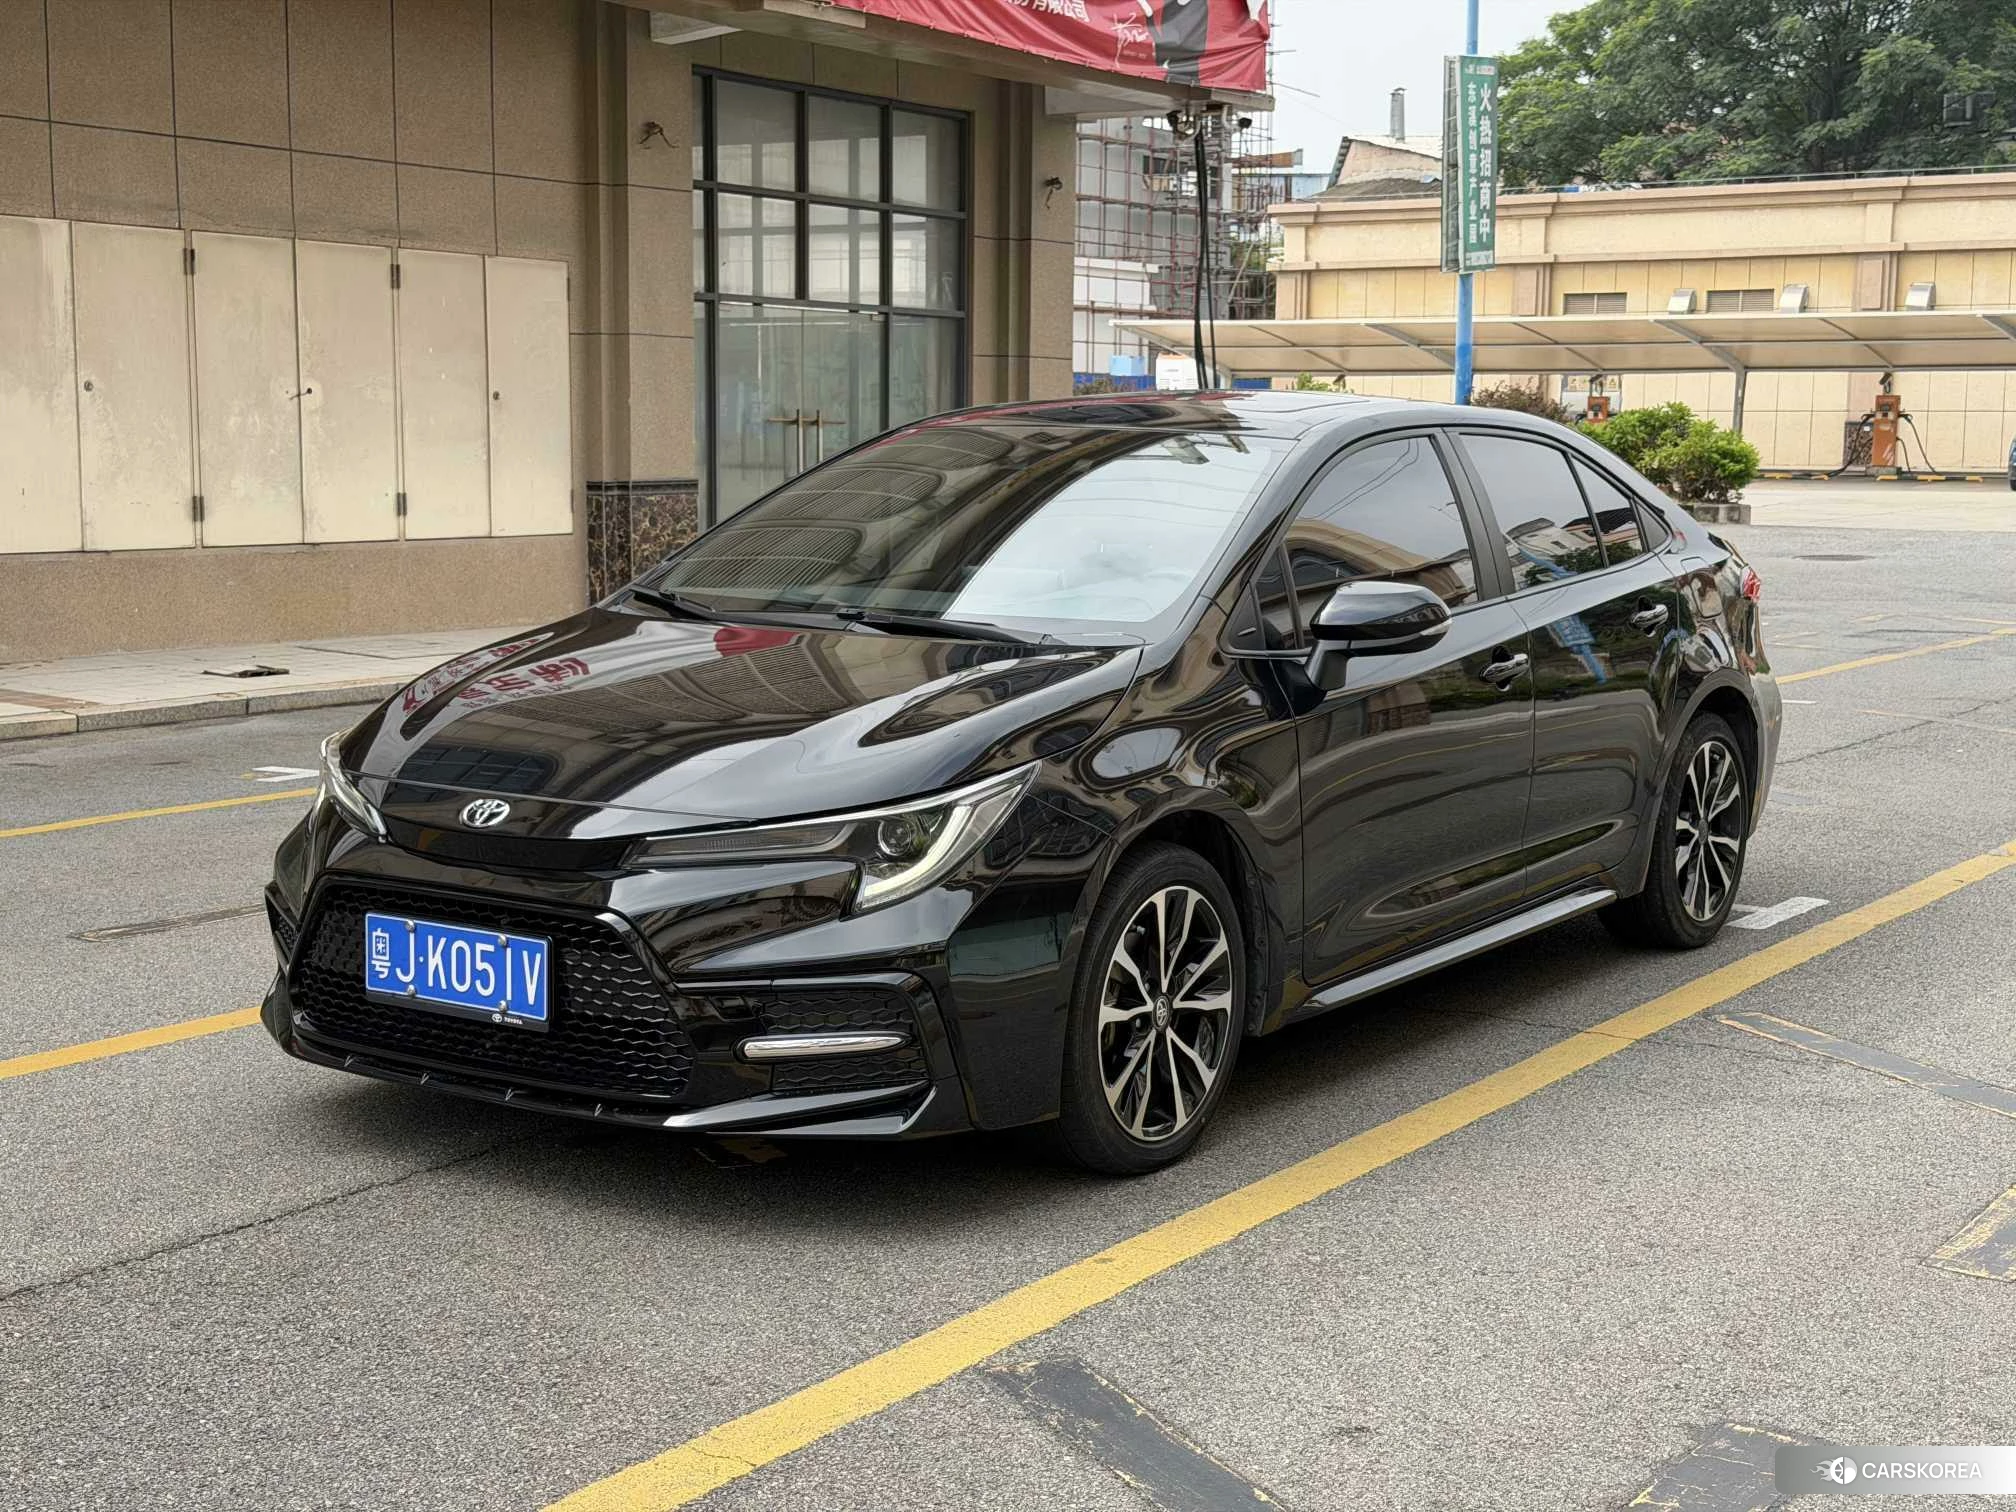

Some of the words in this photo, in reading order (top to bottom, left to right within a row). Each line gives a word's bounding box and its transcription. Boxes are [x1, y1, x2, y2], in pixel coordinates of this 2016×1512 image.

[1480, 83, 1492, 242] 火热招商中
